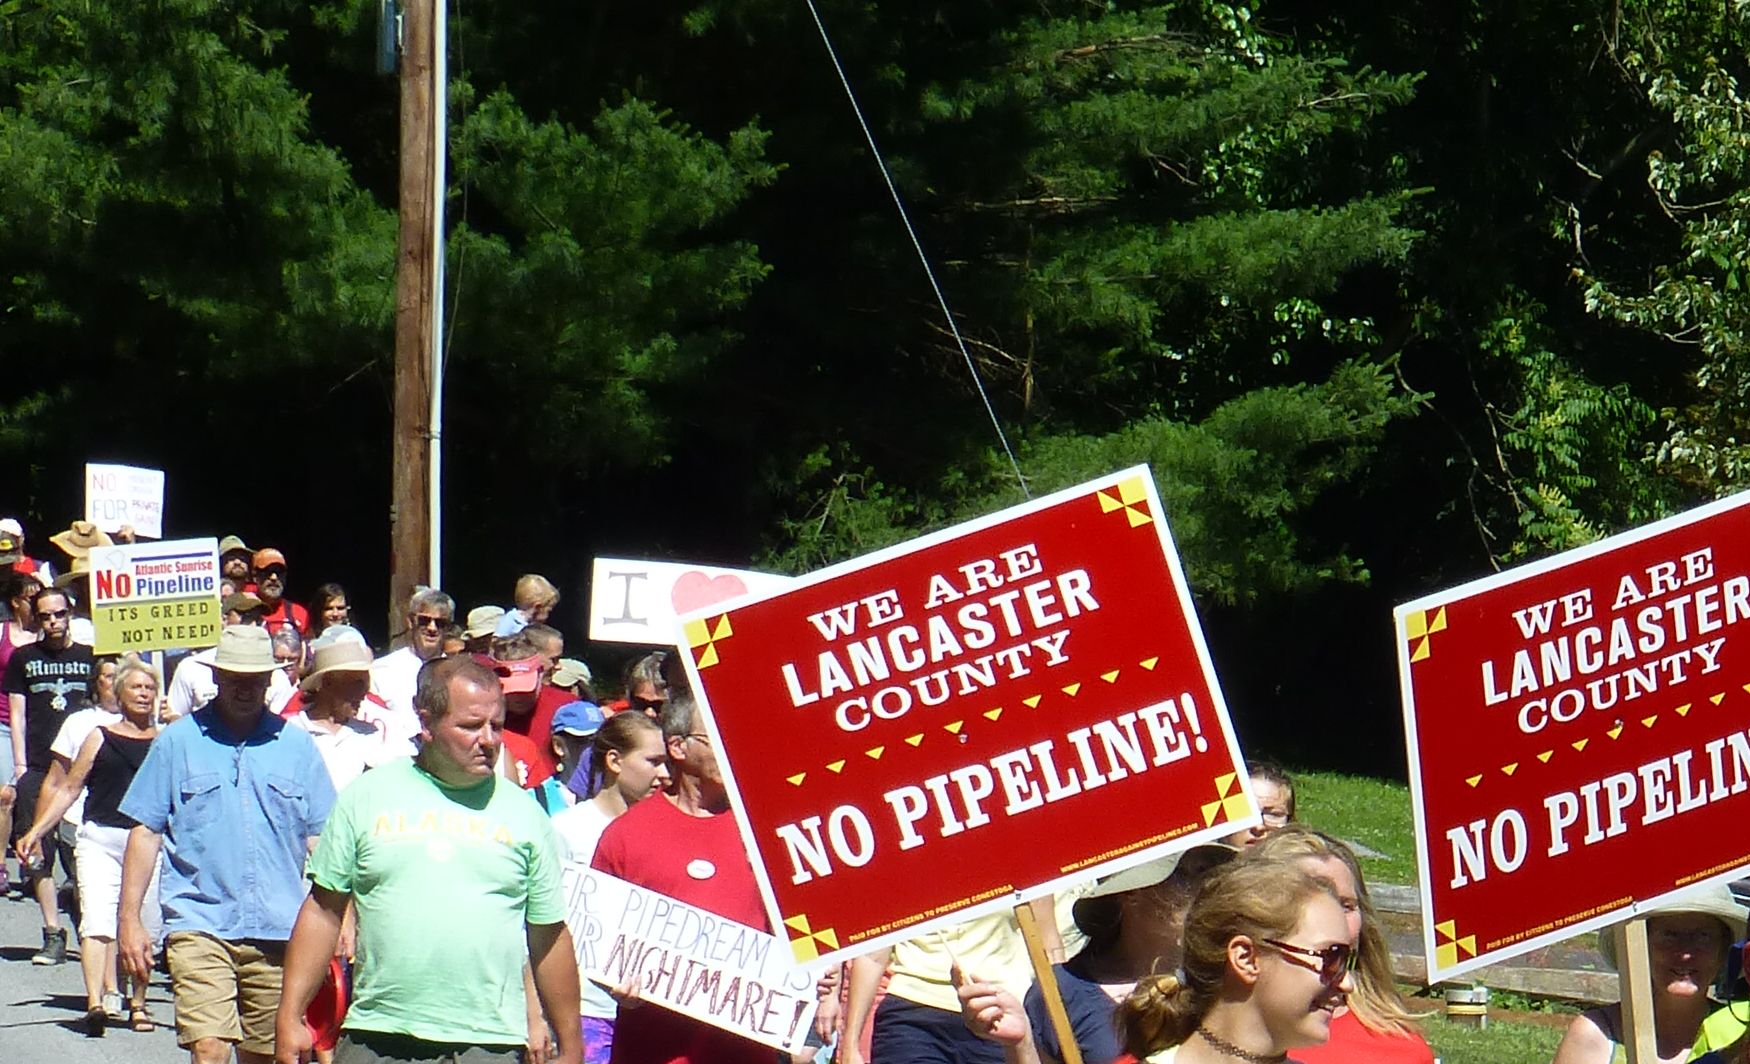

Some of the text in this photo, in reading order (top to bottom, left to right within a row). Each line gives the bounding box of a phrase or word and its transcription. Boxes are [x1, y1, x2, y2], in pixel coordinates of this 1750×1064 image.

[93, 499, 128, 520] FOR
[135, 560, 213, 576] Atlantic Sunrise
[136, 575, 214, 597] Pipeline
[603, 571, 648, 626] I
[806, 543, 1043, 642] WE ARE
[1512, 547, 1714, 639] WE ARE
[122, 628, 154, 643] NOT
[150, 602, 208, 618] GREED
[782, 568, 1100, 707] LANCASTER
[835, 629, 1071, 733] COUNTY
[1518, 637, 1726, 734] COUNTY
[373, 810, 513, 847] ALASKA
[775, 692, 1208, 886] NO PIPELINE!
[1446, 808, 1528, 890] NO
[618, 888, 772, 978] PIPEDREAM
[849, 932, 865, 942] PAID
[866, 928, 881, 936] FOR
[882, 924, 891, 932] BY
[892, 914, 924, 928] CITIZENS
[936, 898, 971, 914] PRESERVE
[603, 933, 809, 1048] NIGHTMARE!
